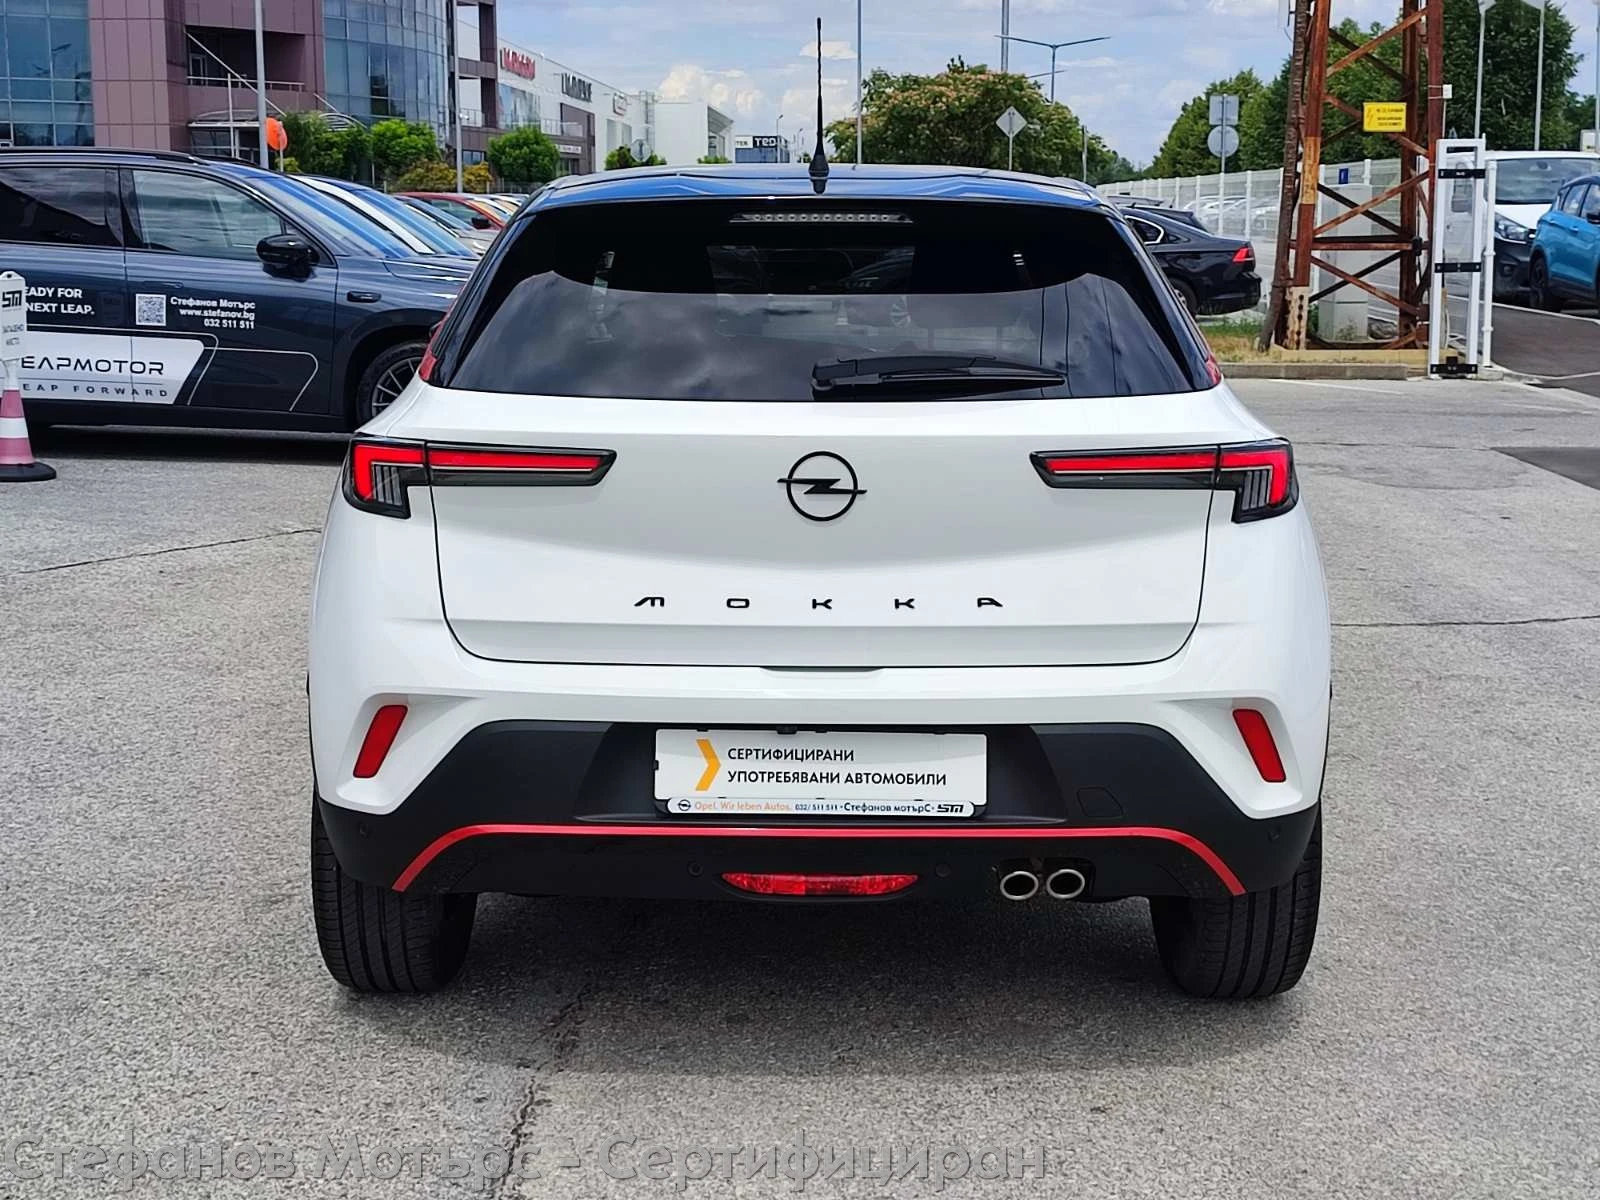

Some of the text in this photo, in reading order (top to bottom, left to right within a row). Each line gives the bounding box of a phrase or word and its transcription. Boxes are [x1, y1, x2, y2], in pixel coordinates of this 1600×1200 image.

[25, 286, 83, 298] EADY FOR
[26, 302, 95, 315] NEXT LEAP.
[170, 296, 256, 310] Стефанов Мотърс
[179, 308, 256, 321] www.stefanov.bg
[203, 318, 255, 329] 032 511 511
[21, 355, 164, 375] EAPMOTOR
[23, 383, 168, 397] EAP FORWARD
[634, 596, 1003, 610] MOKKA
[727, 747, 854, 762] СЕРТИФИЦИРАНИ
[727, 770, 947, 786] УПОТРЕБЯВАНИ АВТОМОБИЛИ
[695, 801, 717, 811] Opel.
[720, 801, 735, 810] Wir
[736, 801, 761, 811] leben
[843, 802, 892, 813] Стефанов
